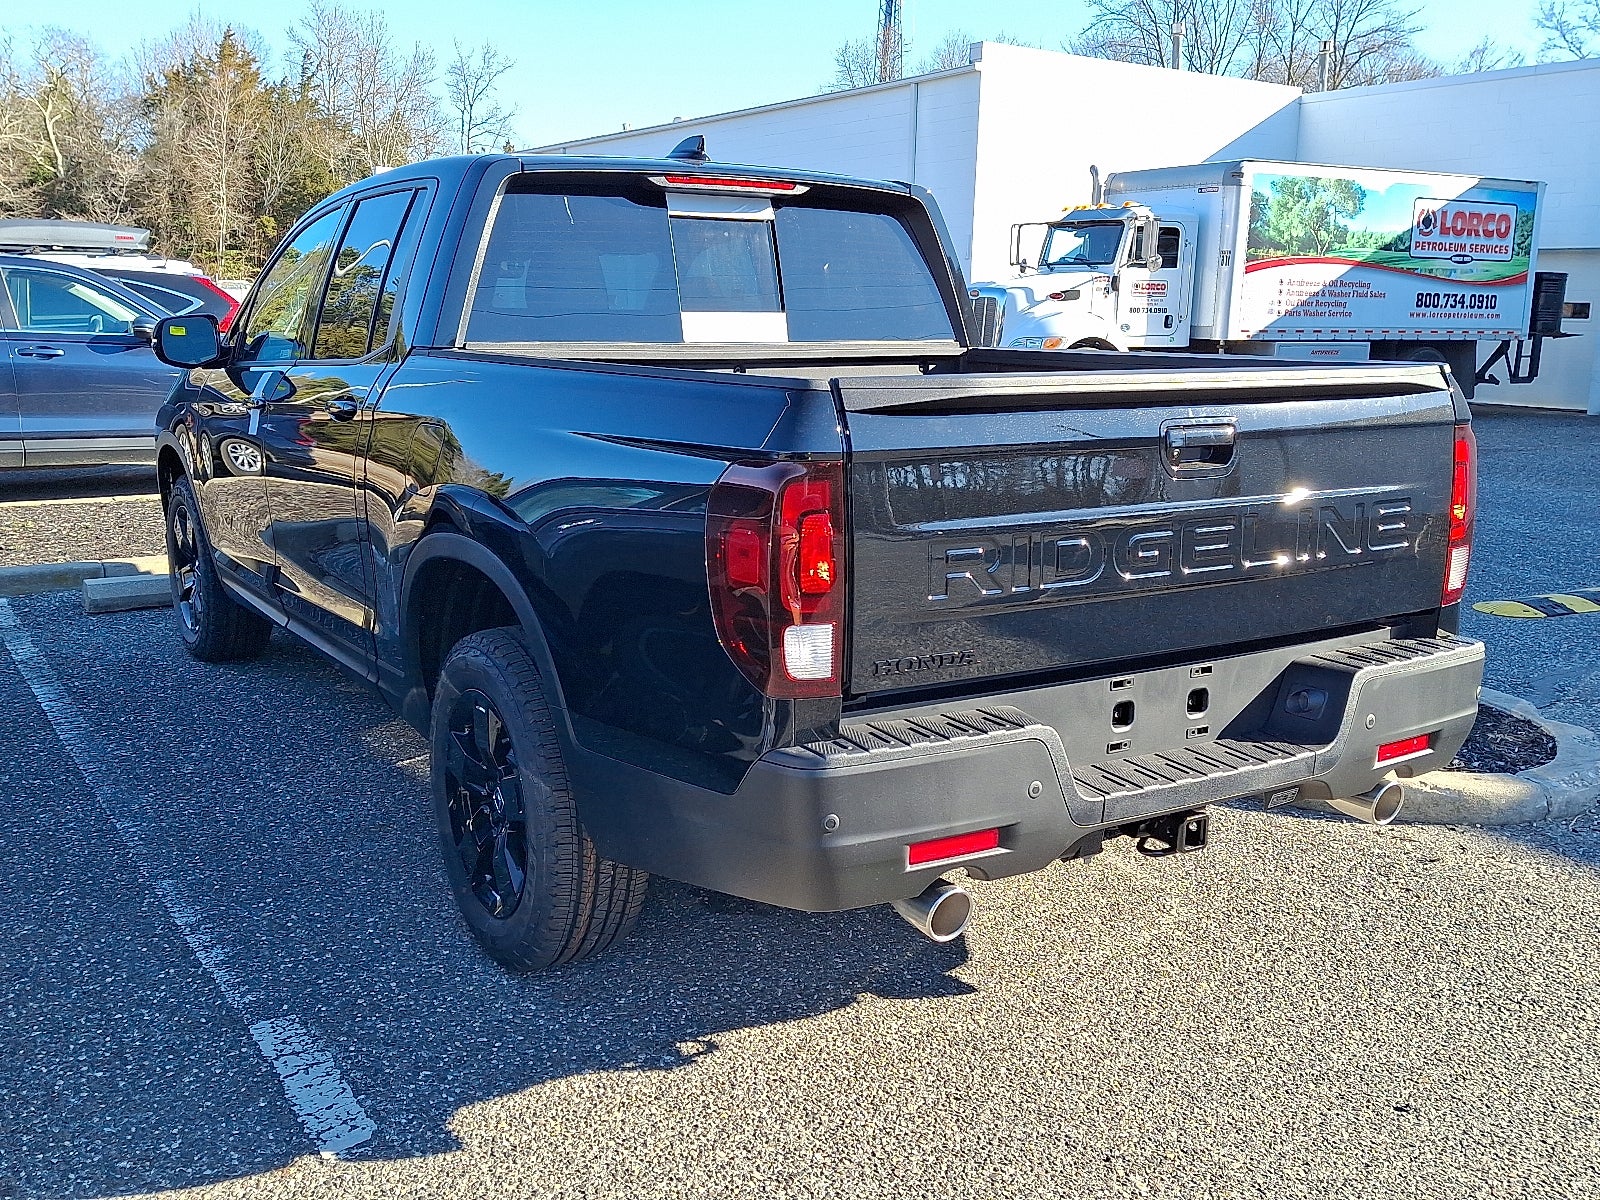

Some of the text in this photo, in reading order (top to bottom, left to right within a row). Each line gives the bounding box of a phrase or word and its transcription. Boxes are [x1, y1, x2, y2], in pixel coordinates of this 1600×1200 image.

[1439, 210, 1511, 239] LORCO
[1414, 240, 1510, 255] PETROLEUM SERVICES
[1328, 279, 1338, 288] Oil
[1339, 280, 1371, 289] Recycling
[1327, 289, 1352, 298] Washer
[1352, 290, 1369, 298] Fluid
[1314, 299, 1347, 309] Recycling
[1415, 292, 1498, 310] 800.734.0910
[1284, 308, 1301, 317] Parts
[1302, 309, 1327, 317] Washer
[1409, 310, 1501, 320] www.lorcopetroleum.com
[928, 499, 1411, 601] RIDGELINE
[873, 650, 979, 676] HONDA
